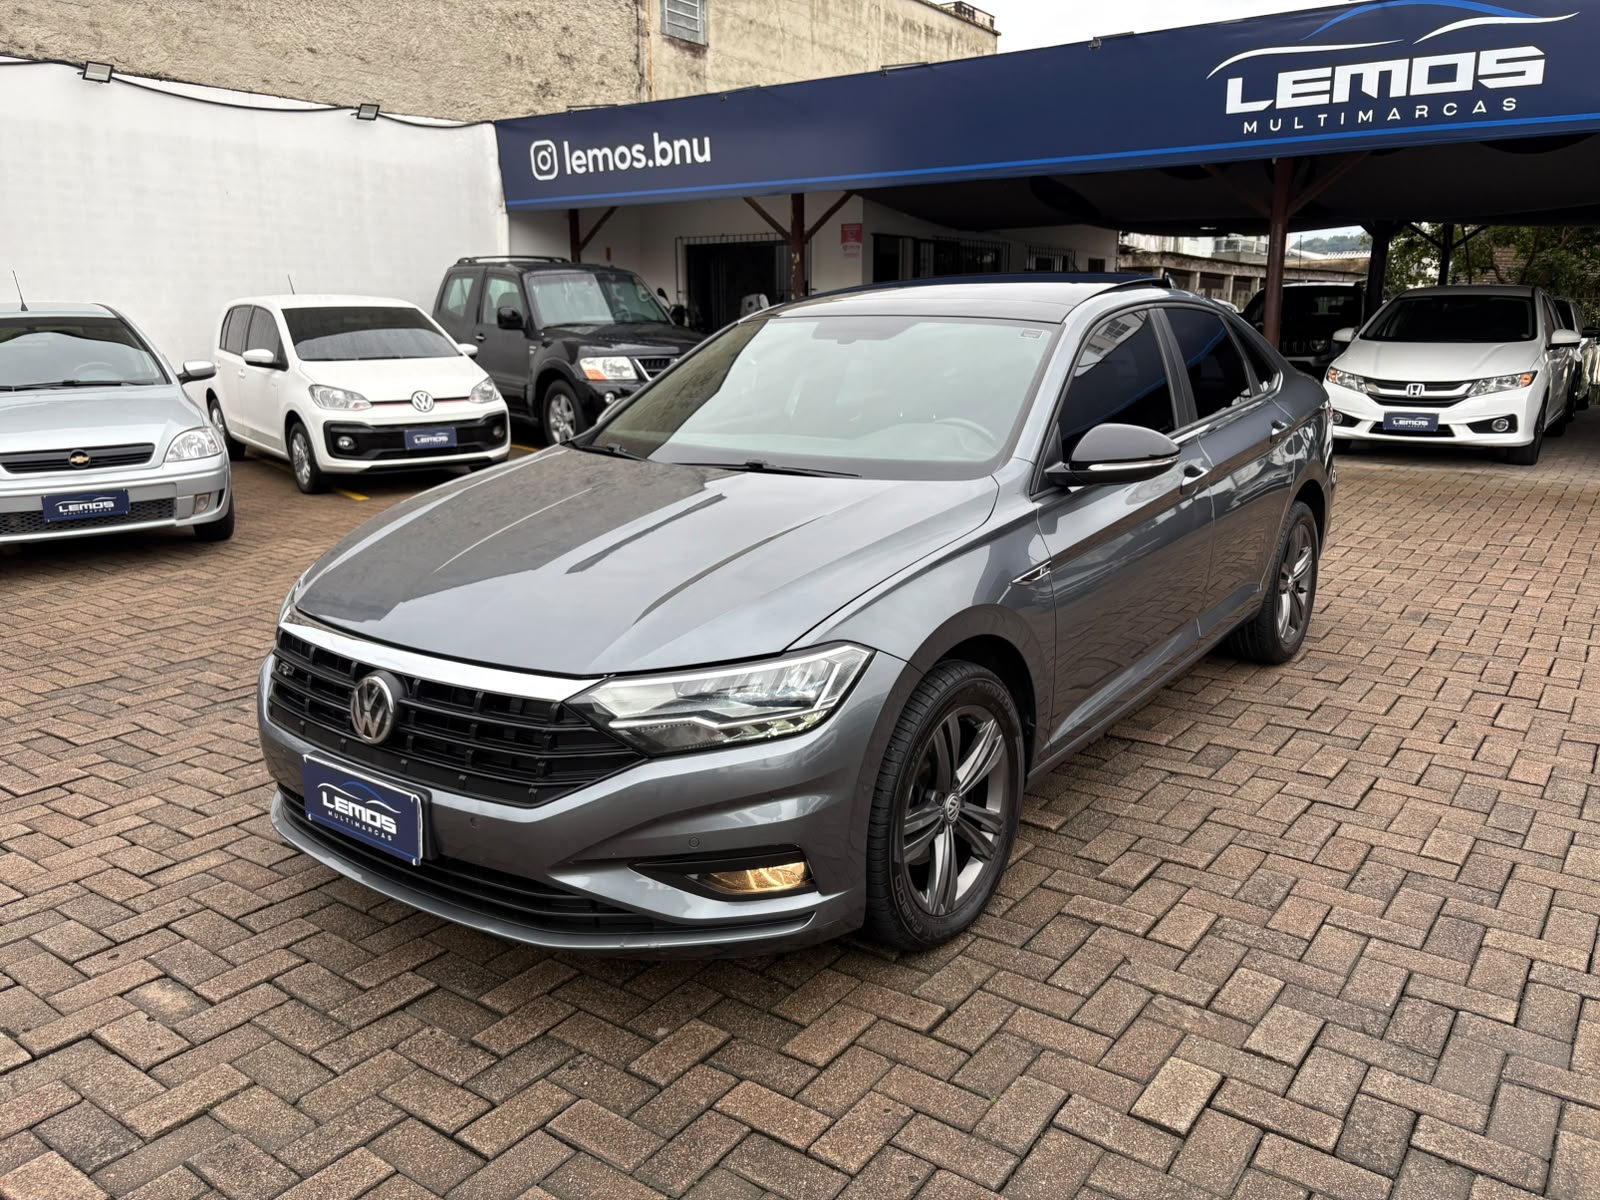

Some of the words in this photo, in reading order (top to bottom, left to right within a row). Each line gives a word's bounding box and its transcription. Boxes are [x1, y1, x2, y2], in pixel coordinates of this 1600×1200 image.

[1225, 45, 1546, 115] LEMOS
[1242, 97, 1517, 135] MULTIMARCAS
[562, 131, 712, 175] lemos.bnu
[59, 501, 115, 512] LEMOS
[321, 791, 398, 835] LEMOS
[327, 809, 393, 842] MULTIMARCAS
